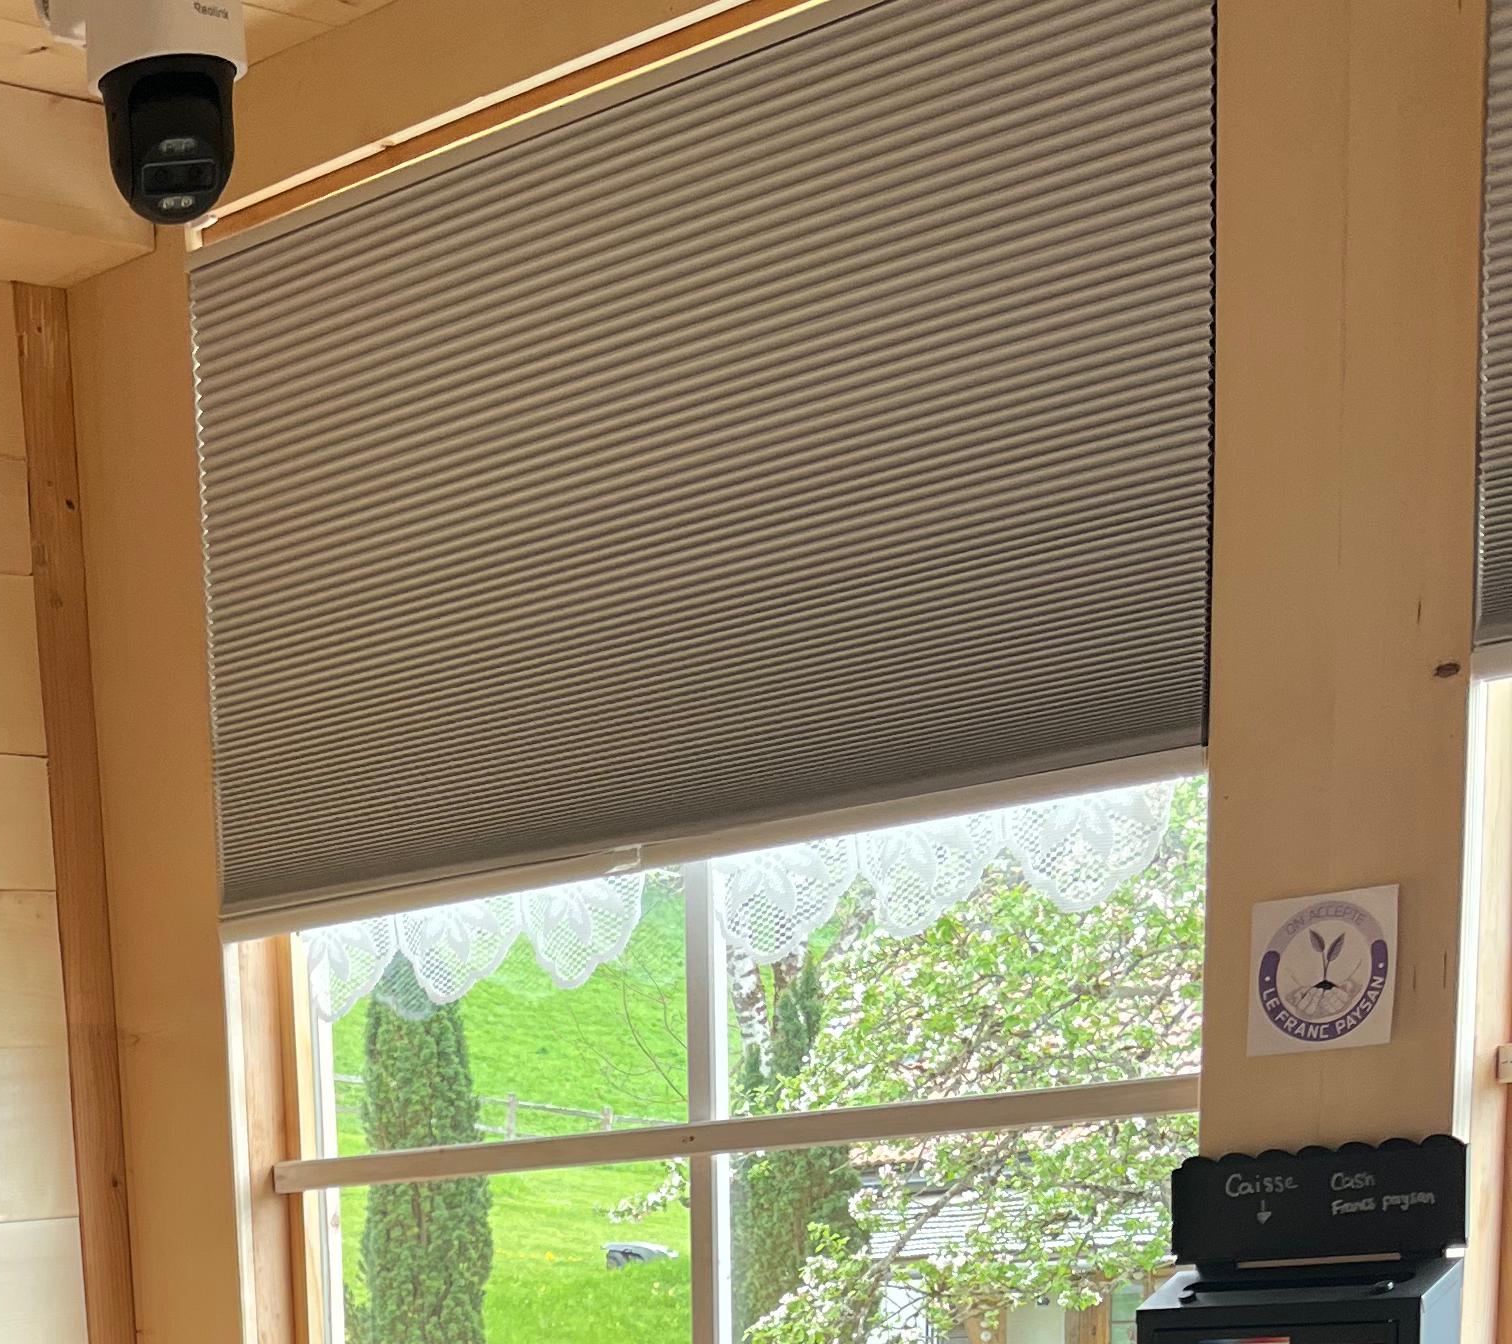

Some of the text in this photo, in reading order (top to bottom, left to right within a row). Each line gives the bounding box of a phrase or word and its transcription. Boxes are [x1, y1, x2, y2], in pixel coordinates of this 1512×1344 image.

[1262, 975, 1385, 1039] LE FRANC PAYSAN
[1225, 1173, 1299, 1198] Caisse
[1330, 1172, 1375, 1191] Cash
